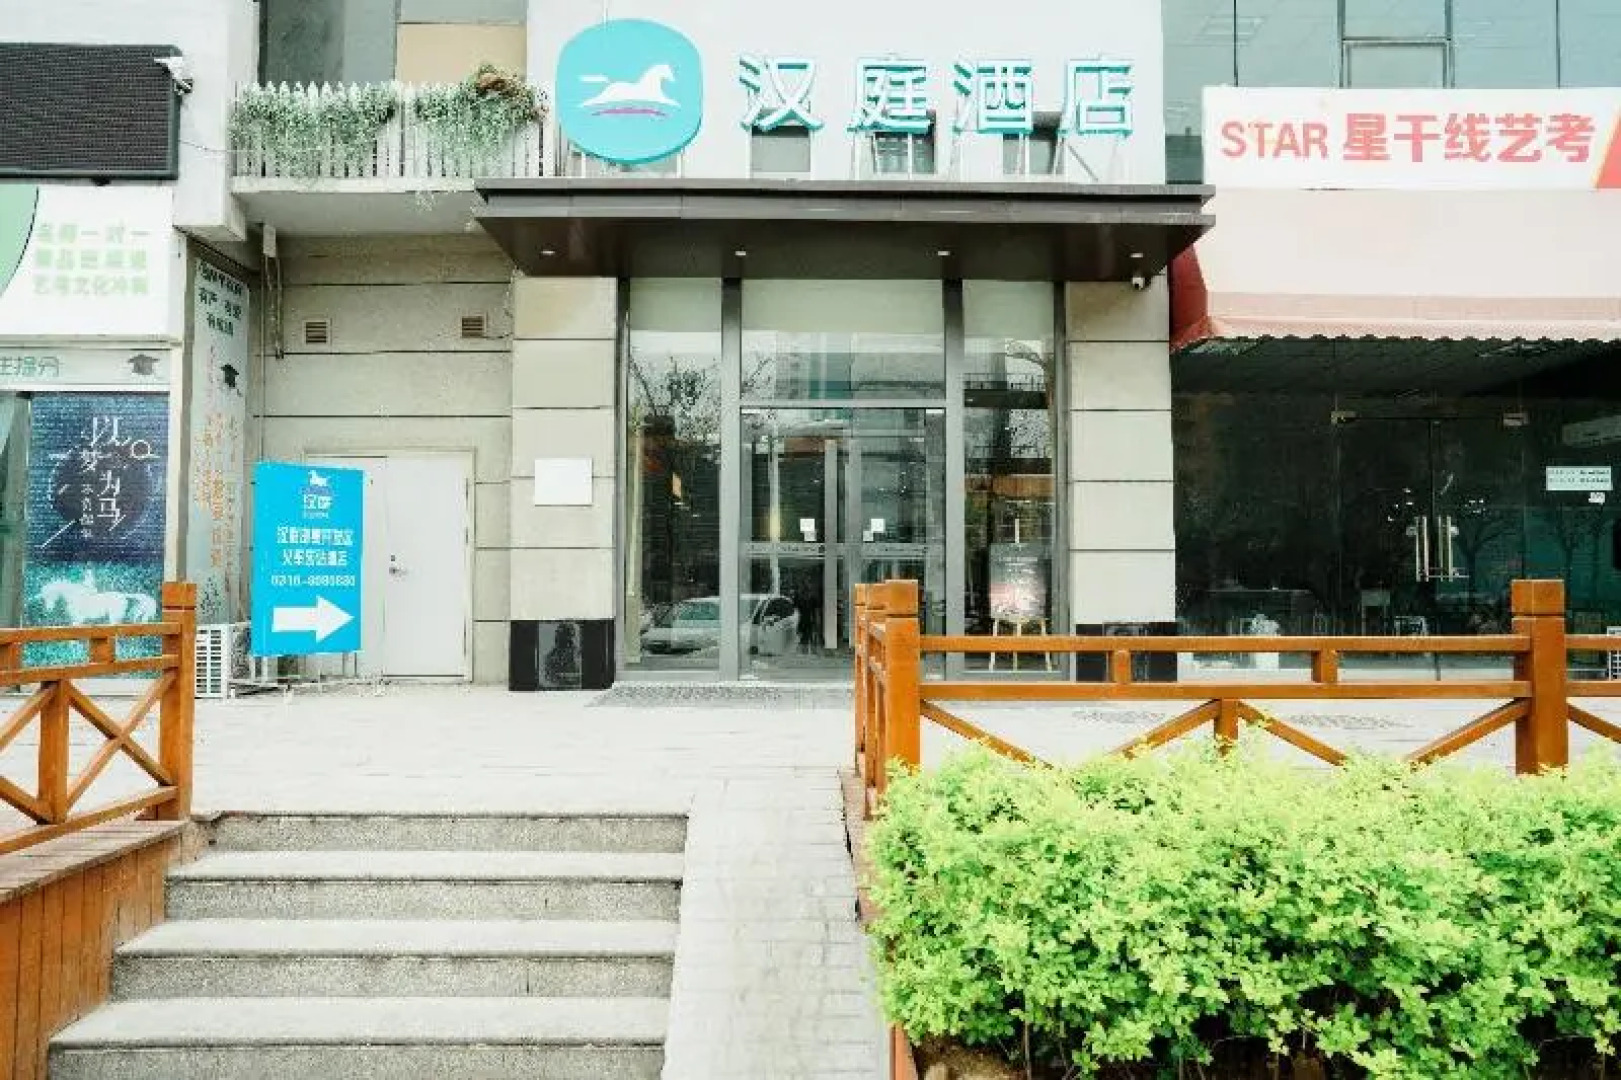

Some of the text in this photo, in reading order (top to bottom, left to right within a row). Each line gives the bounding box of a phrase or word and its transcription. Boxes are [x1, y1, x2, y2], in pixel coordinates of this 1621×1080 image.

[739, 53, 1134, 137] 汉庭酒店
[1220, 121, 1329, 160] STAR
